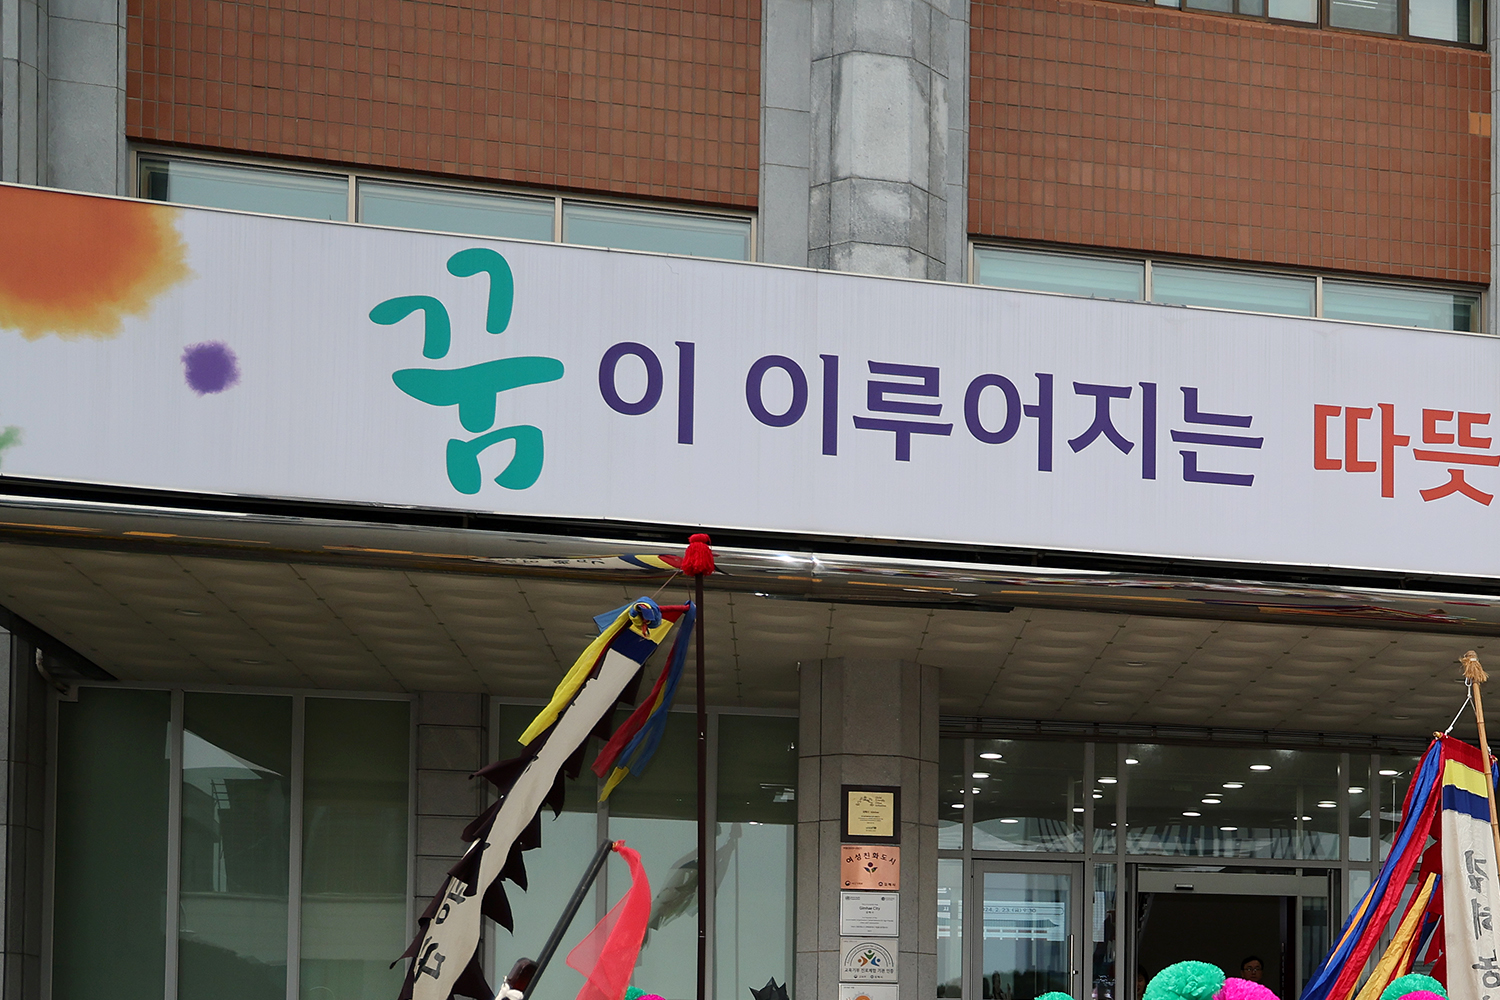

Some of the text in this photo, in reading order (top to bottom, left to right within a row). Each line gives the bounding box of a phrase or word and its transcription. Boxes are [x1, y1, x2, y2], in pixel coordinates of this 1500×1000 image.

[369, 247, 695, 495] 꿈이
[745, 354, 1264, 487] 이루어지는
[846, 852, 897, 865] 여성친화도시
